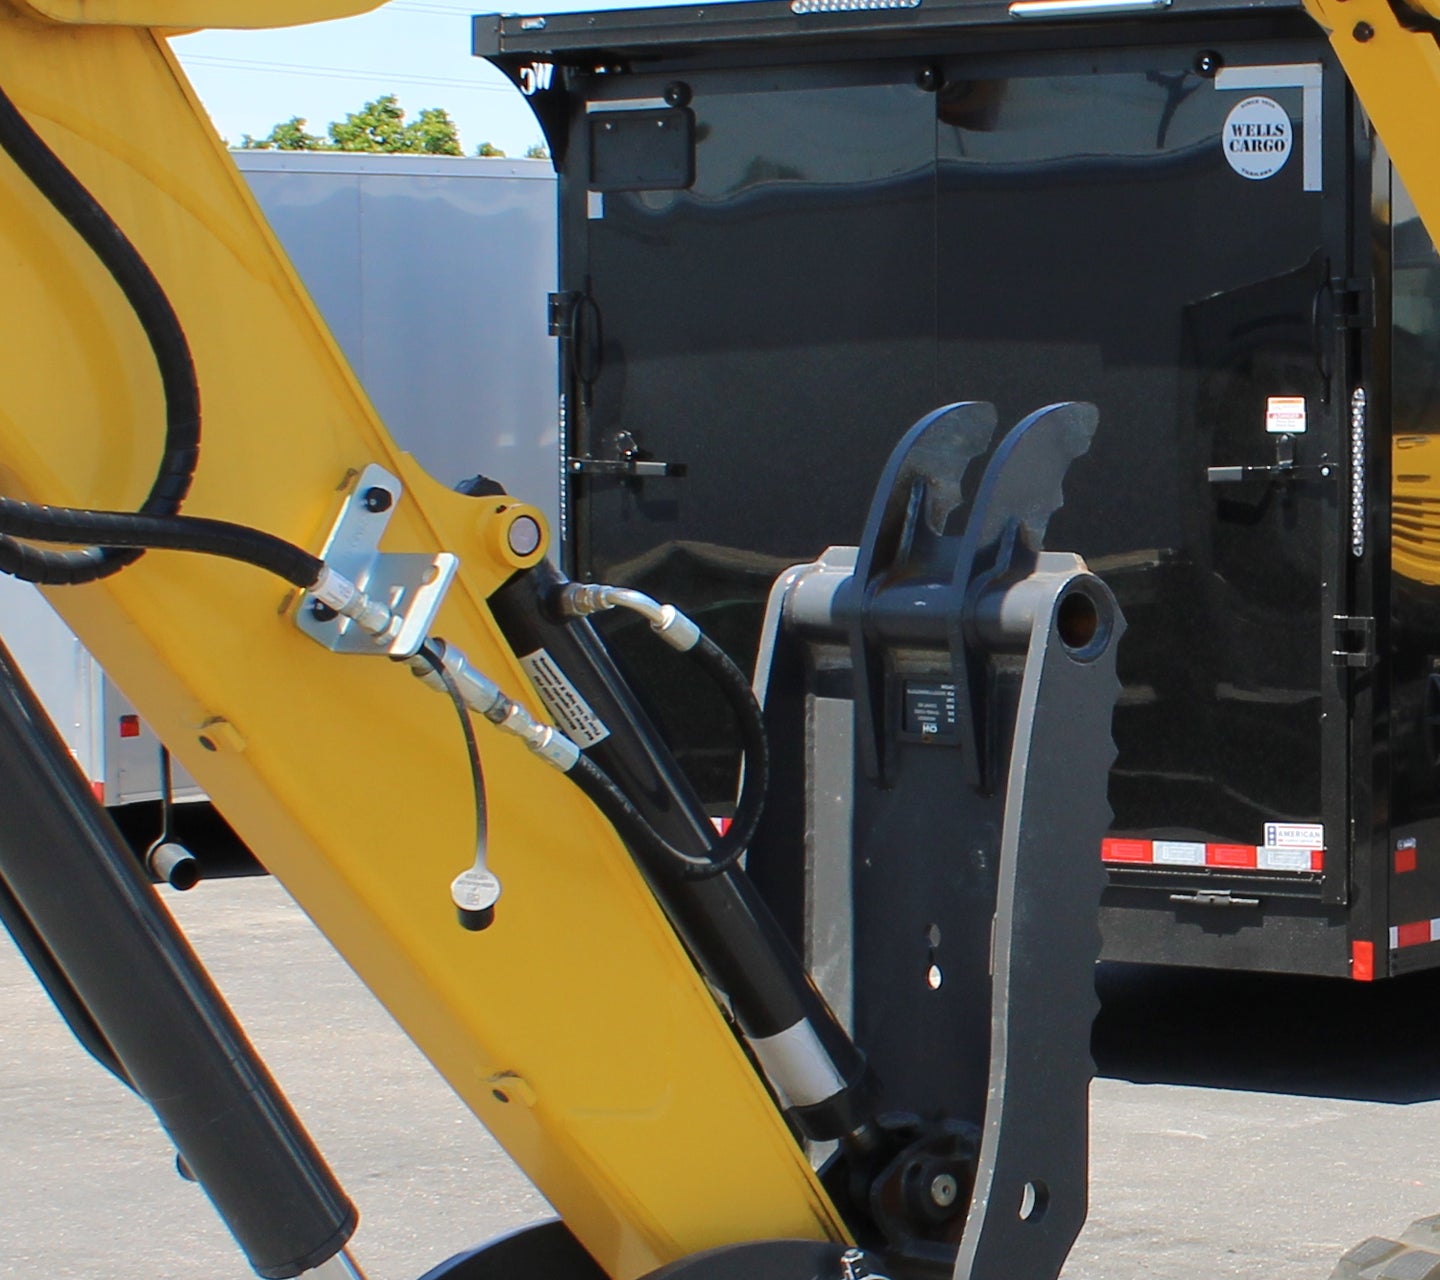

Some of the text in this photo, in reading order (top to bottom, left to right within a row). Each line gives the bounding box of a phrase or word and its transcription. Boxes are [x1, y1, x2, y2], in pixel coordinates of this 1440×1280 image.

[1231, 123, 1285, 137] WELLS
[1229, 138, 1286, 153] CARGO
[1278, 830, 1320, 838] AMERICAN
